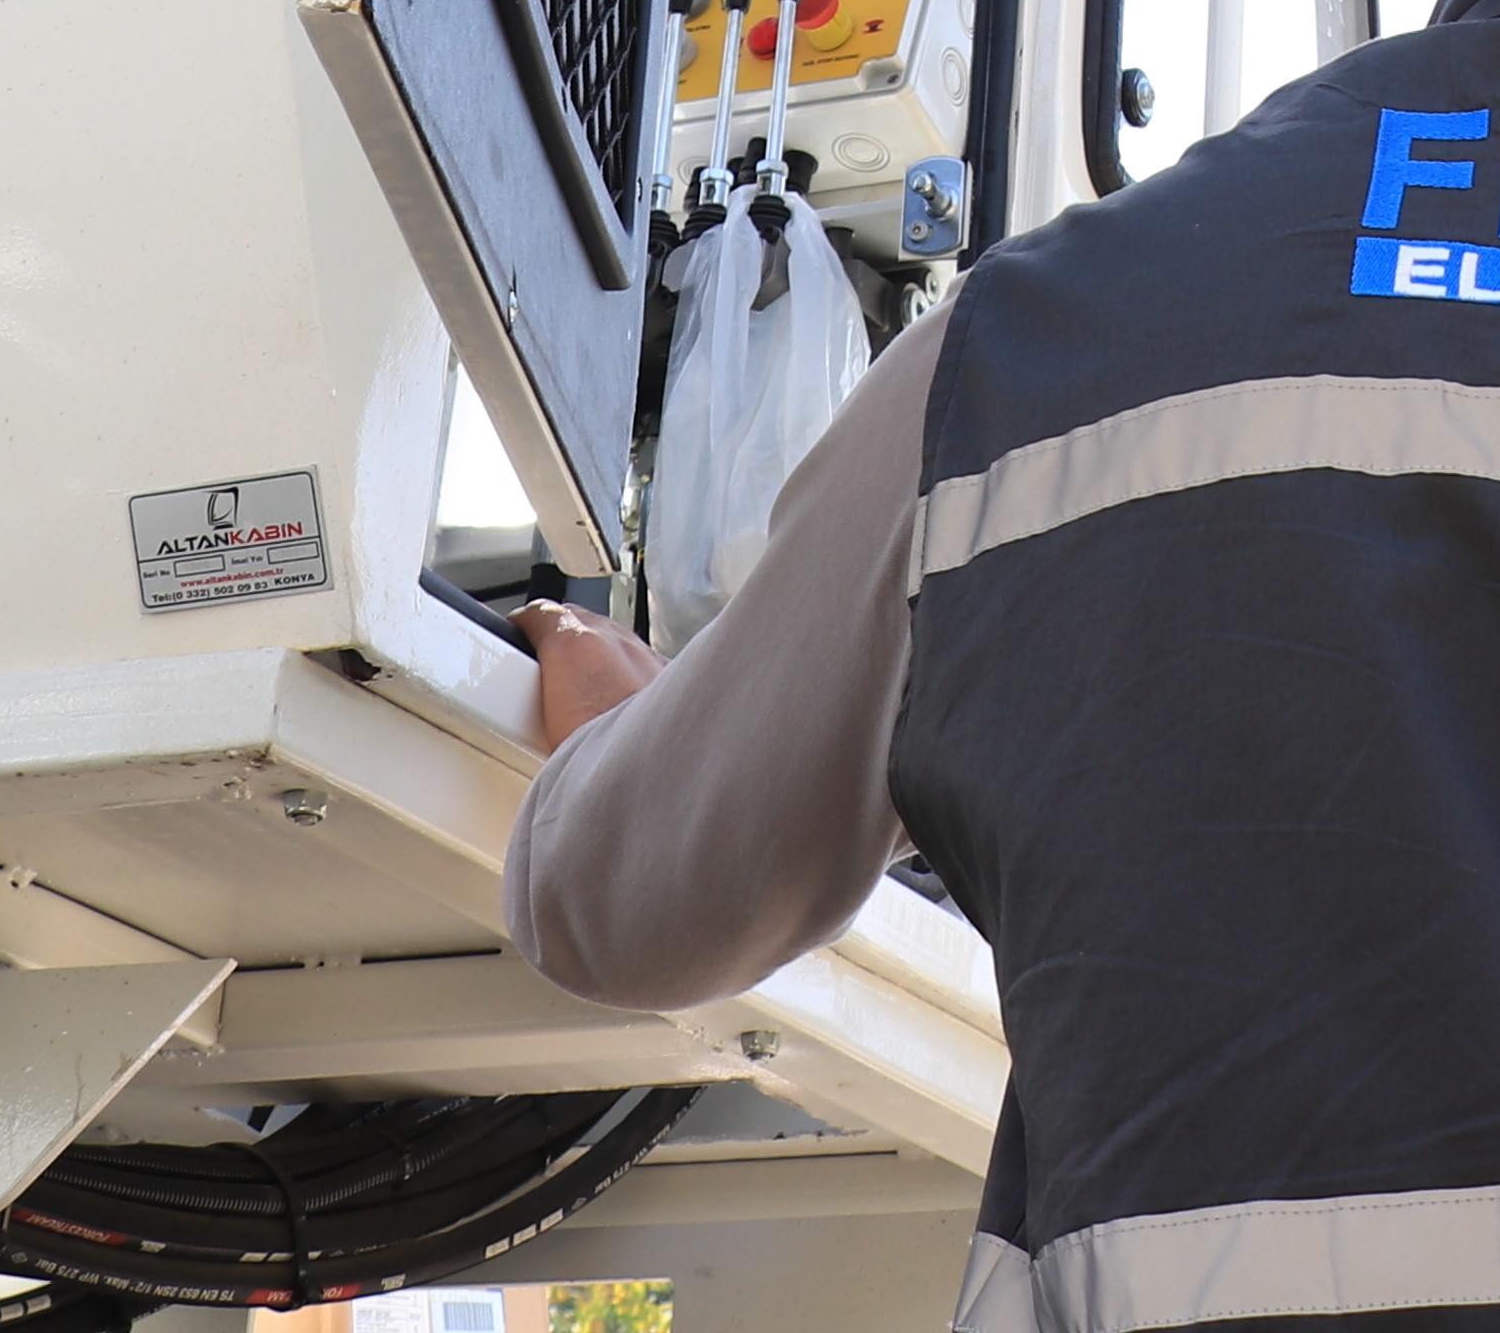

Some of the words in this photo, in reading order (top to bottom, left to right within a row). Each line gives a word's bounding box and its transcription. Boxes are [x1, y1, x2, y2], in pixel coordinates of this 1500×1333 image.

[180, 567, 284, 588] www.altankabin.com.tr
[186, 588, 211, 600] 332)
[214, 585, 235, 596] 502
[274, 573, 316, 586] KONYA
[56, 1264, 81, 1280] 275
[78, 1270, 100, 1285] WP
[104, 1275, 132, 1292] Max.
[153, 1284, 179, 1298] 2SN
[178, 1287, 199, 1300] 853
[200, 1289, 222, 1301] EN
[220, 1289, 236, 1301] TS
